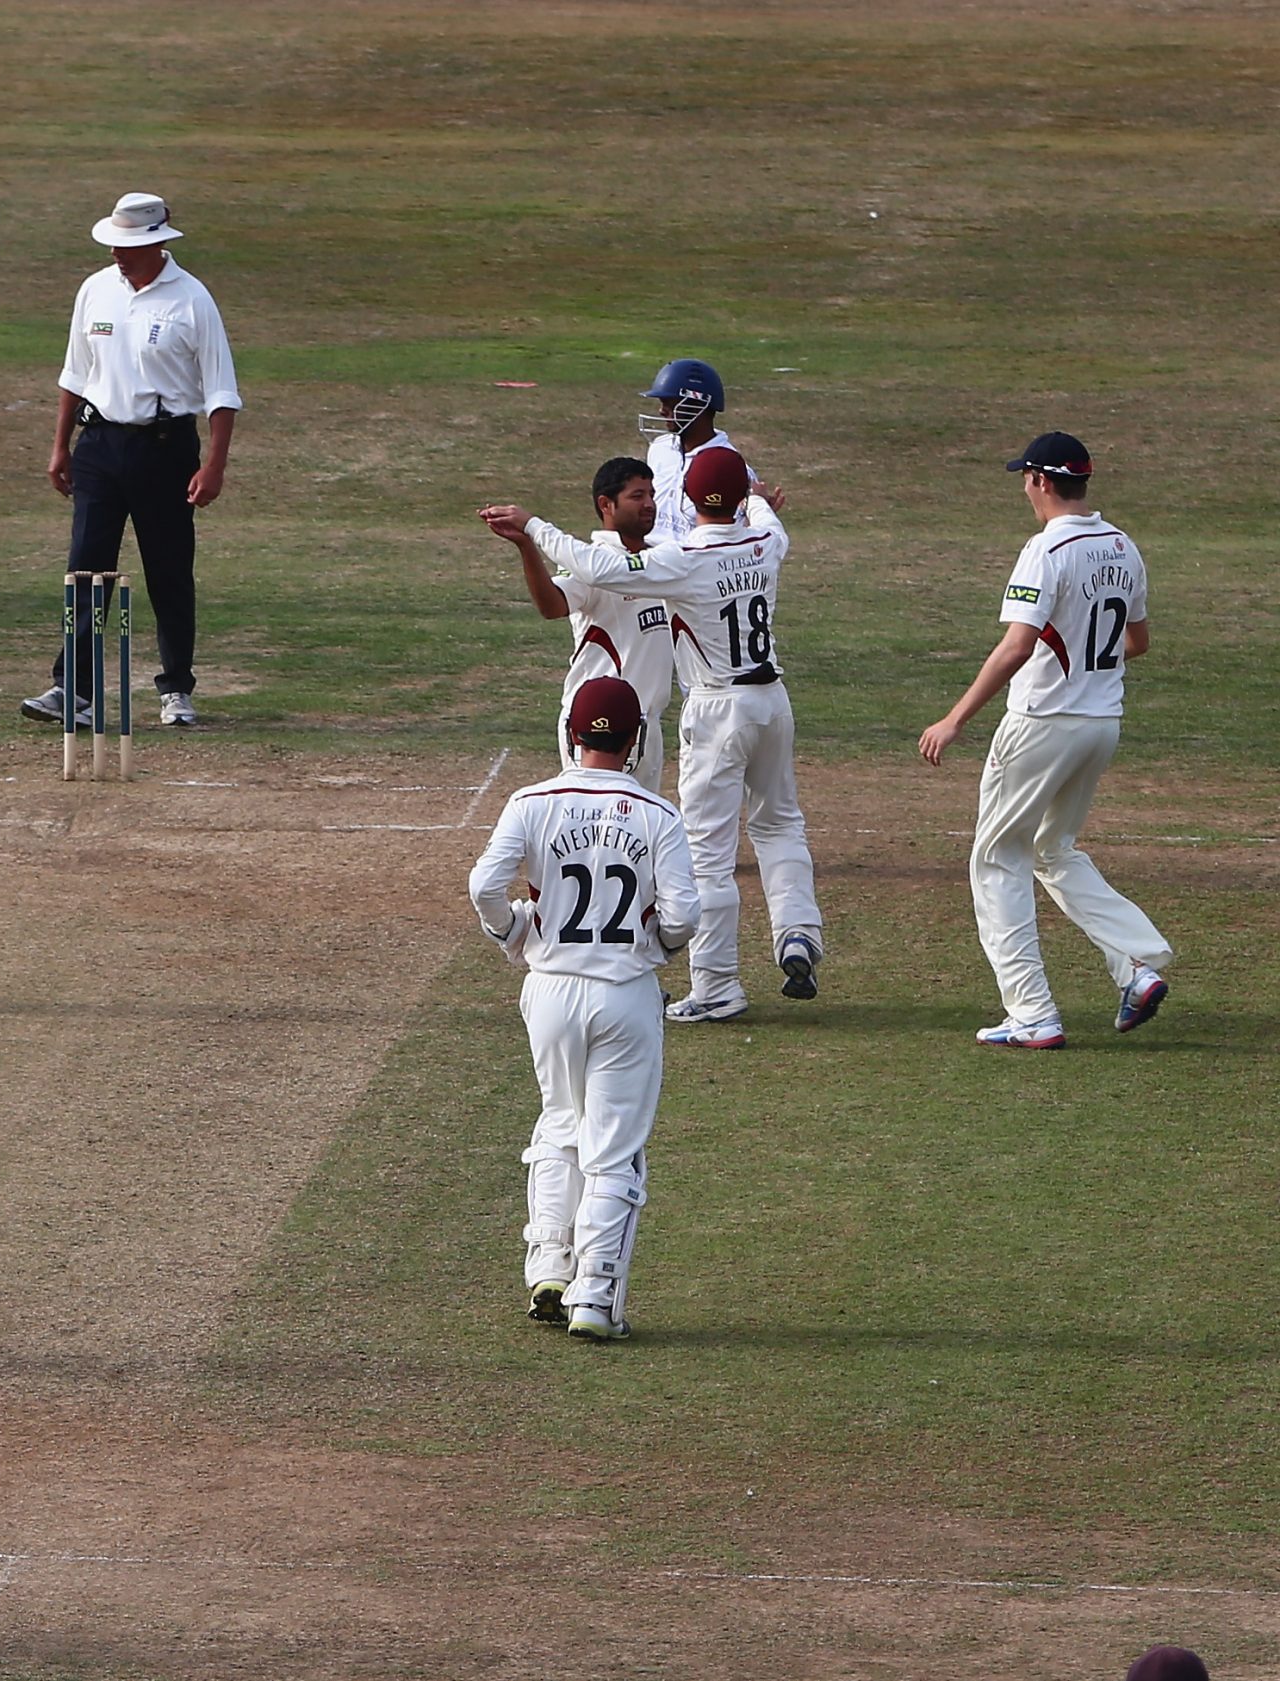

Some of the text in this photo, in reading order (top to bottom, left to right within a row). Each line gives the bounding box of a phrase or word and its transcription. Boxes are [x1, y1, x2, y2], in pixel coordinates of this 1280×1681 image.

[716, 571, 769, 598] BARROW
[1008, 587, 1038, 602] LV=
[720, 595, 771, 668] 18
[1085, 597, 1127, 672] 12
[550, 824, 649, 865] KIESWETTER
[559, 863, 638, 943] 22
